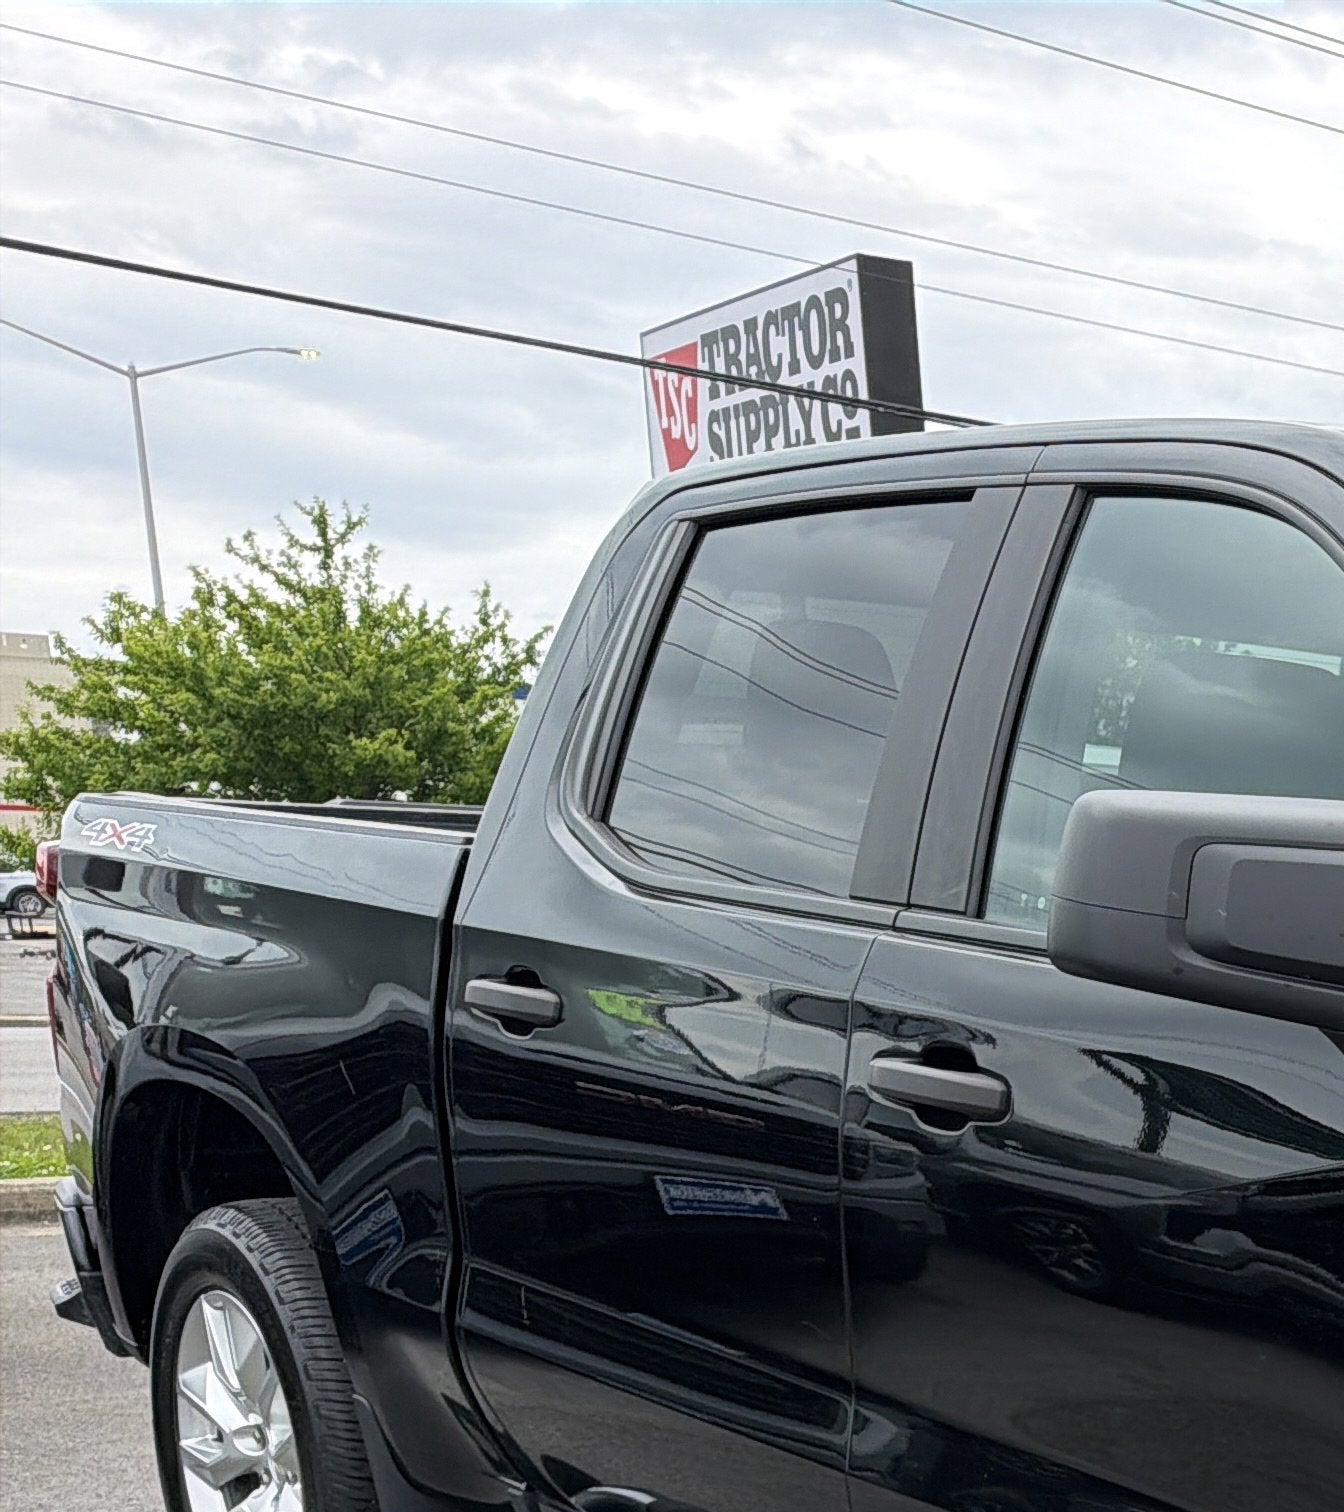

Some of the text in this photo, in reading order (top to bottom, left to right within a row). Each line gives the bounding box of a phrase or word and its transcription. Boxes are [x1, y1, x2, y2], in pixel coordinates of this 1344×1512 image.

[700, 286, 855, 402] TRACTOR
[652, 357, 697, 451] TSC
[707, 380, 817, 462] SUPPLY
